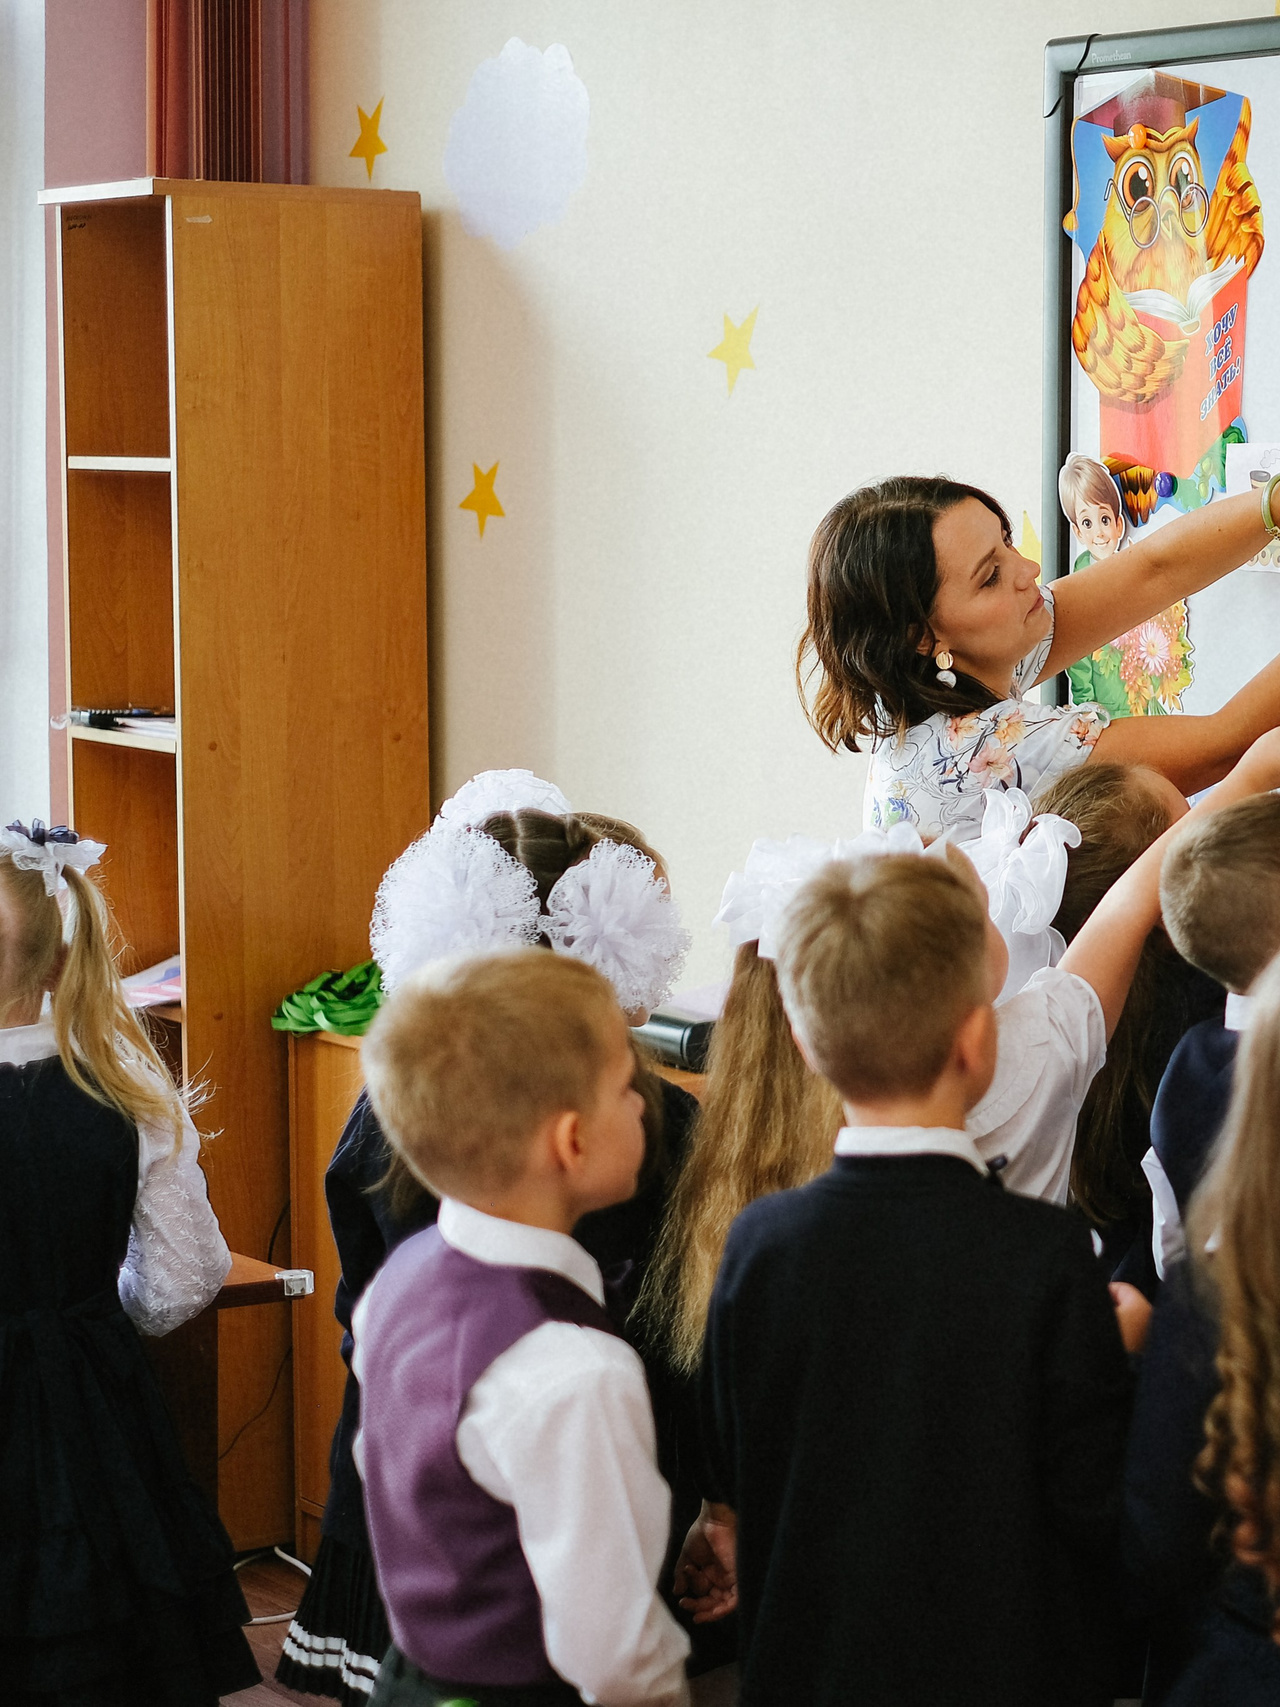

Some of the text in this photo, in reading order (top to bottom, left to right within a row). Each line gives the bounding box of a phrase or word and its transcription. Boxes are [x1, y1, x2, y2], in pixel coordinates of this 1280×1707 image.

[1091, 50, 1132, 64] Promethean
[1205, 303, 1239, 357] ХОЧУ
[1209, 335, 1232, 381] ВСЁ
[1200, 356, 1241, 421] ЗНАТЬ!
